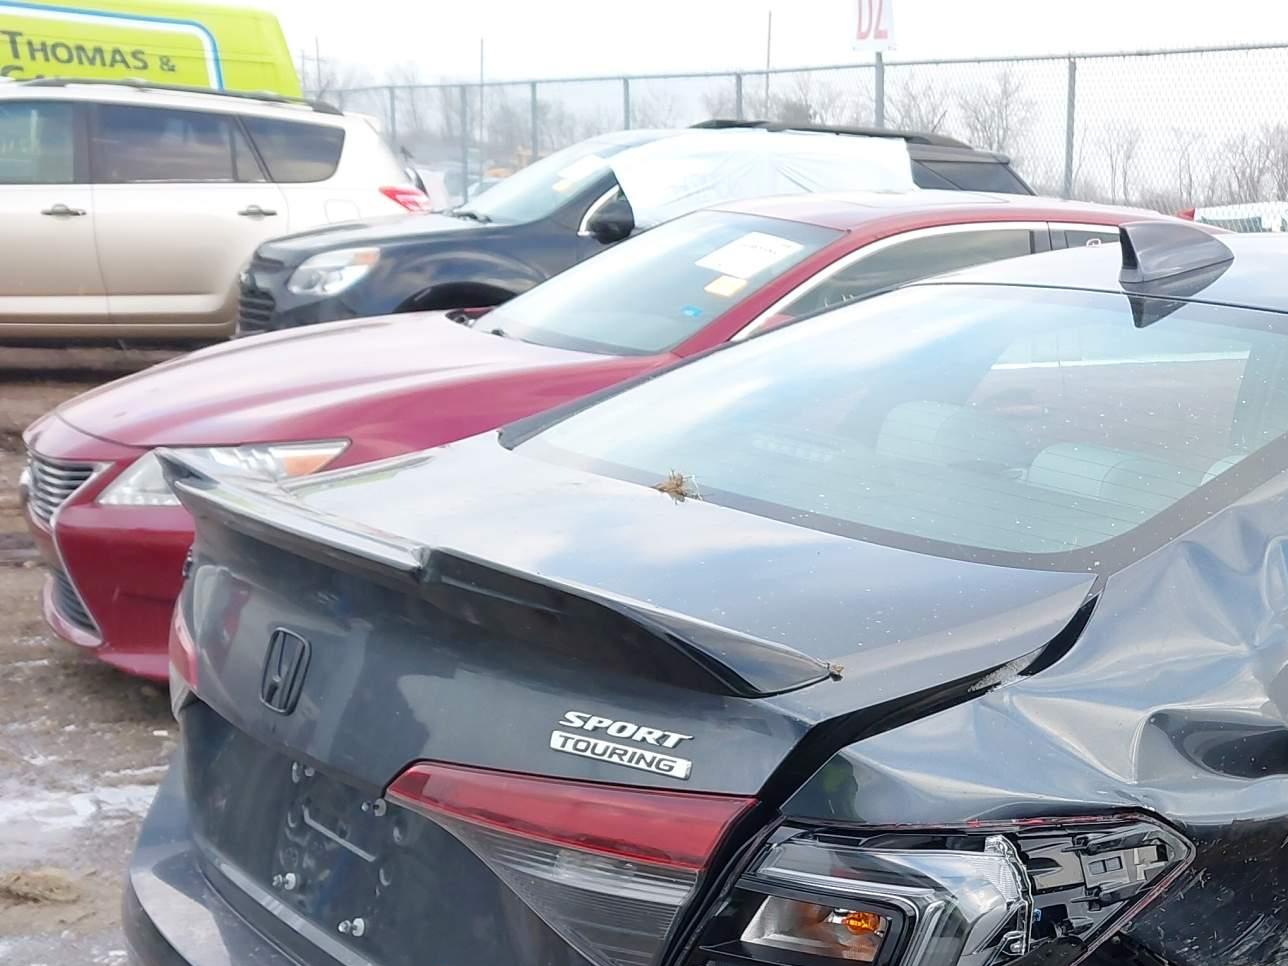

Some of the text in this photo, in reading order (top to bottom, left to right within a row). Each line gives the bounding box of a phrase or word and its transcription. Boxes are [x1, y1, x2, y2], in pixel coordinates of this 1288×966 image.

[855, 0, 889, 40] D2
[0, 30, 177, 73] THOMAS &
[559, 711, 694, 748] SPORT
[559, 734, 677, 773] TOURING
